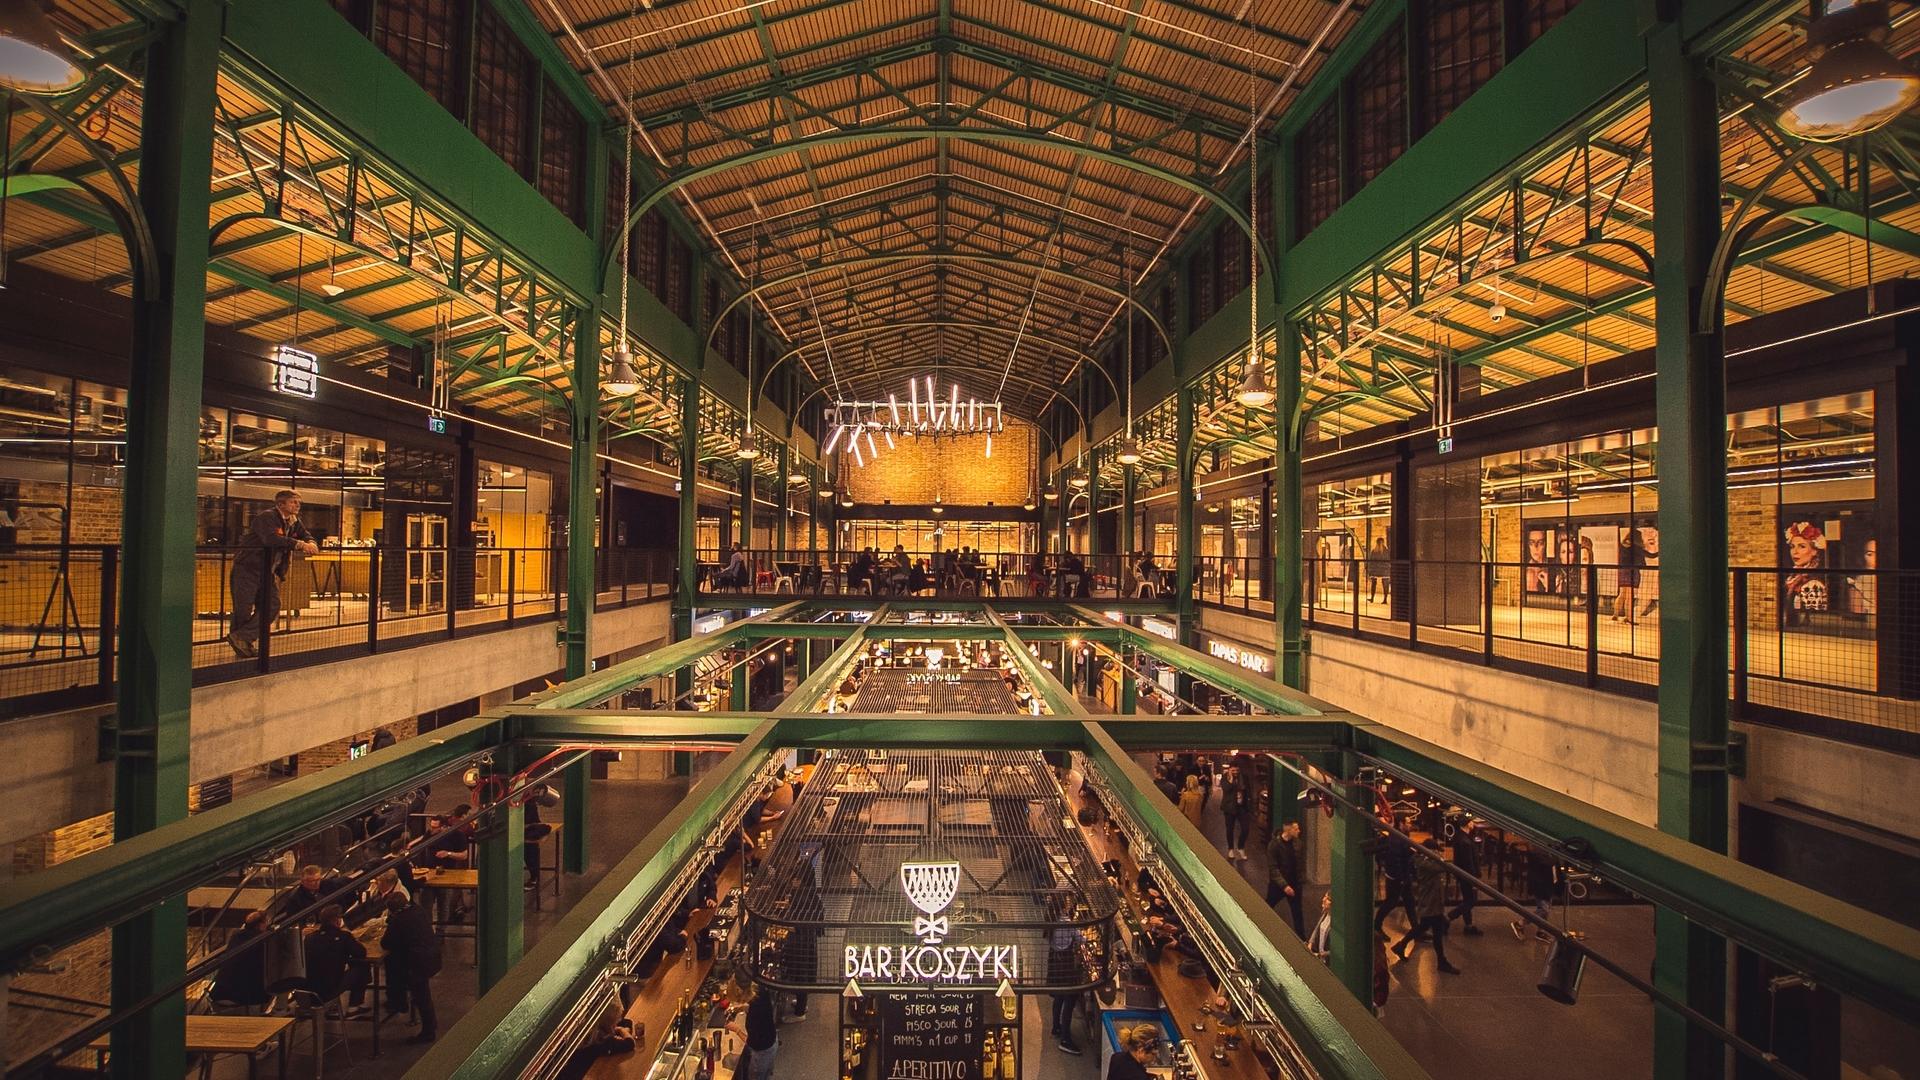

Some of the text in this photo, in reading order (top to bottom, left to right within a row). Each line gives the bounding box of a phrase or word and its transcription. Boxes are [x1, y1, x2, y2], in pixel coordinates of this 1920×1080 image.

[1209, 640, 1268, 673] TAPAS BAR
[845, 945, 1018, 979] BAR KOSZYKI
[905, 1003, 937, 1016] STREGA
[940, 1004, 961, 1015] SOUR
[906, 1020, 932, 1031] PISCO
[934, 1018, 958, 1031] SOUR
[944, 1035, 959, 1044] CUP
[892, 1059, 967, 1080] APERITIVO
